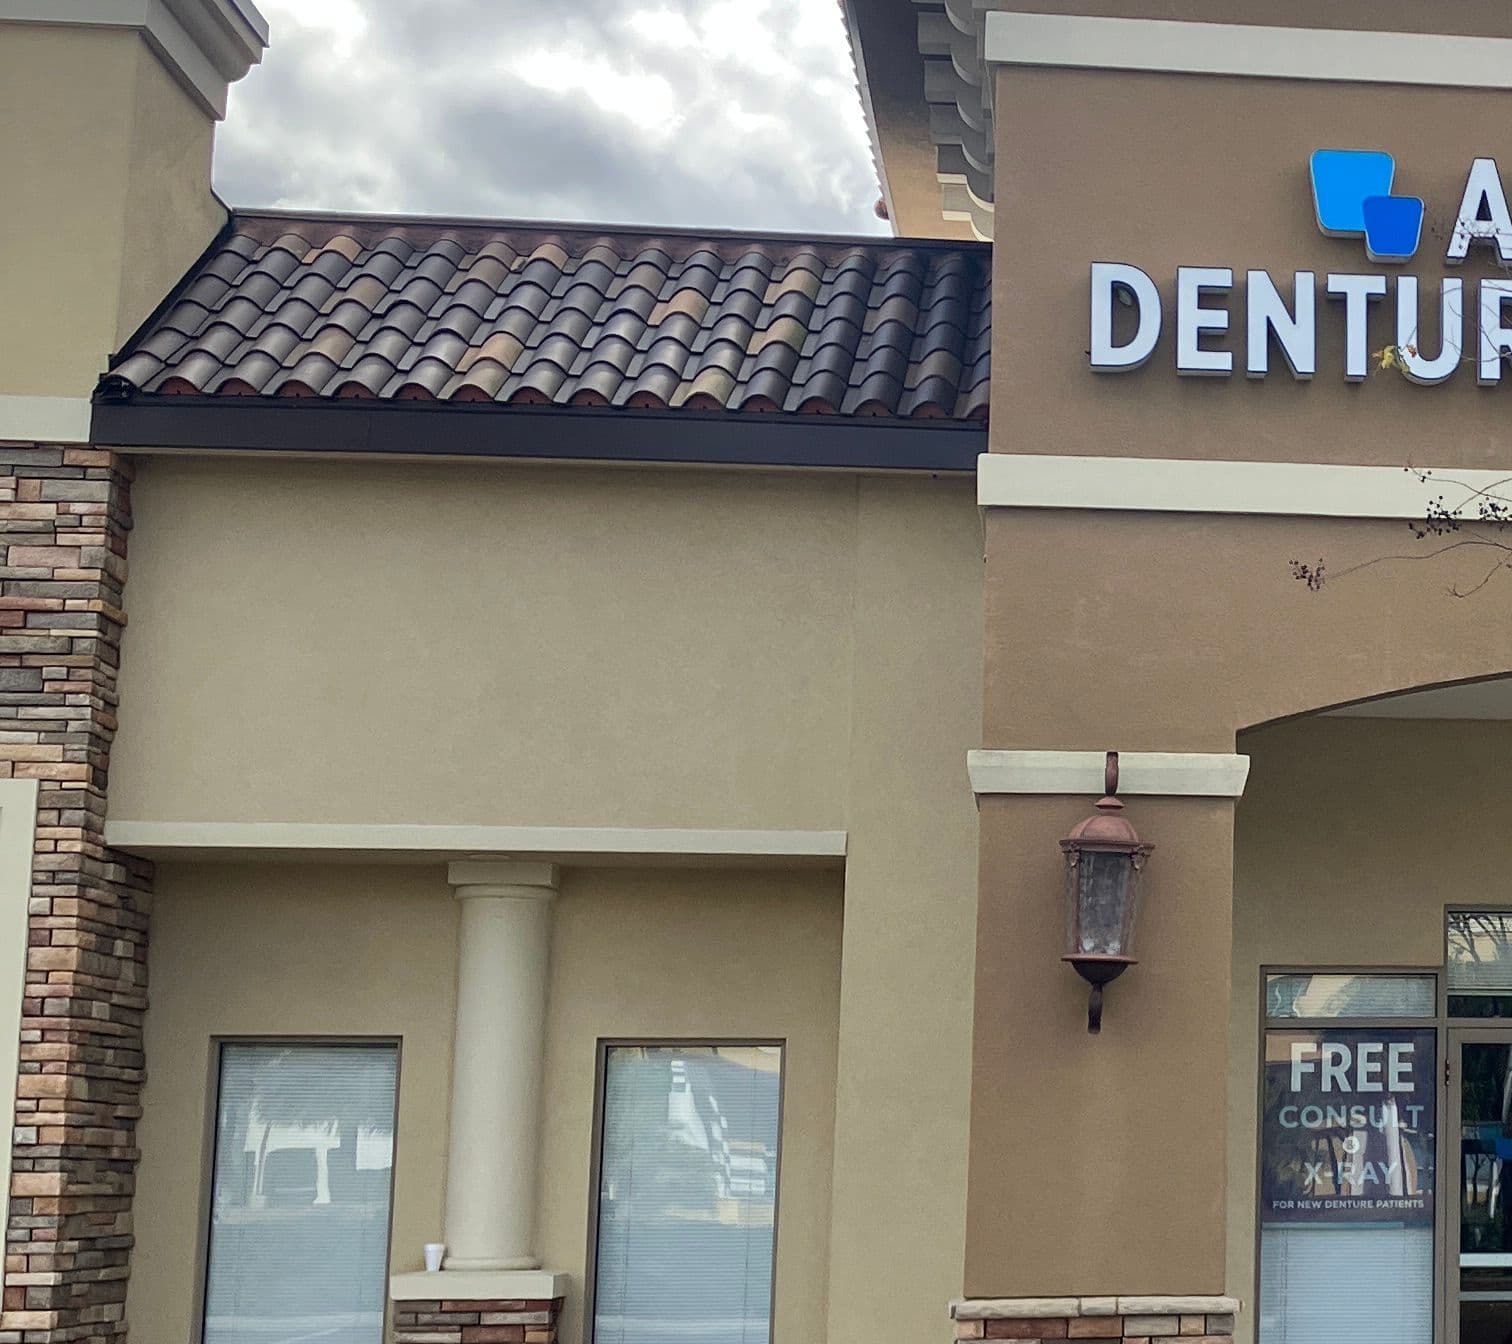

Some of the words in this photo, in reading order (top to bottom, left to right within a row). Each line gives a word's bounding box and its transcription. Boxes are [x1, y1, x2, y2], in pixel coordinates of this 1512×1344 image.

[1289, 1042, 1415, 1092] FREE
[1278, 1105, 1425, 1129] CONSULT
[1303, 1161, 1398, 1185] X-RAY
[1272, 1199, 1295, 1209] FOR
[1297, 1200, 1322, 1209] NEW
[1325, 1199, 1373, 1209] DENTURE
[1376, 1199, 1425, 1209] PATIENTS
